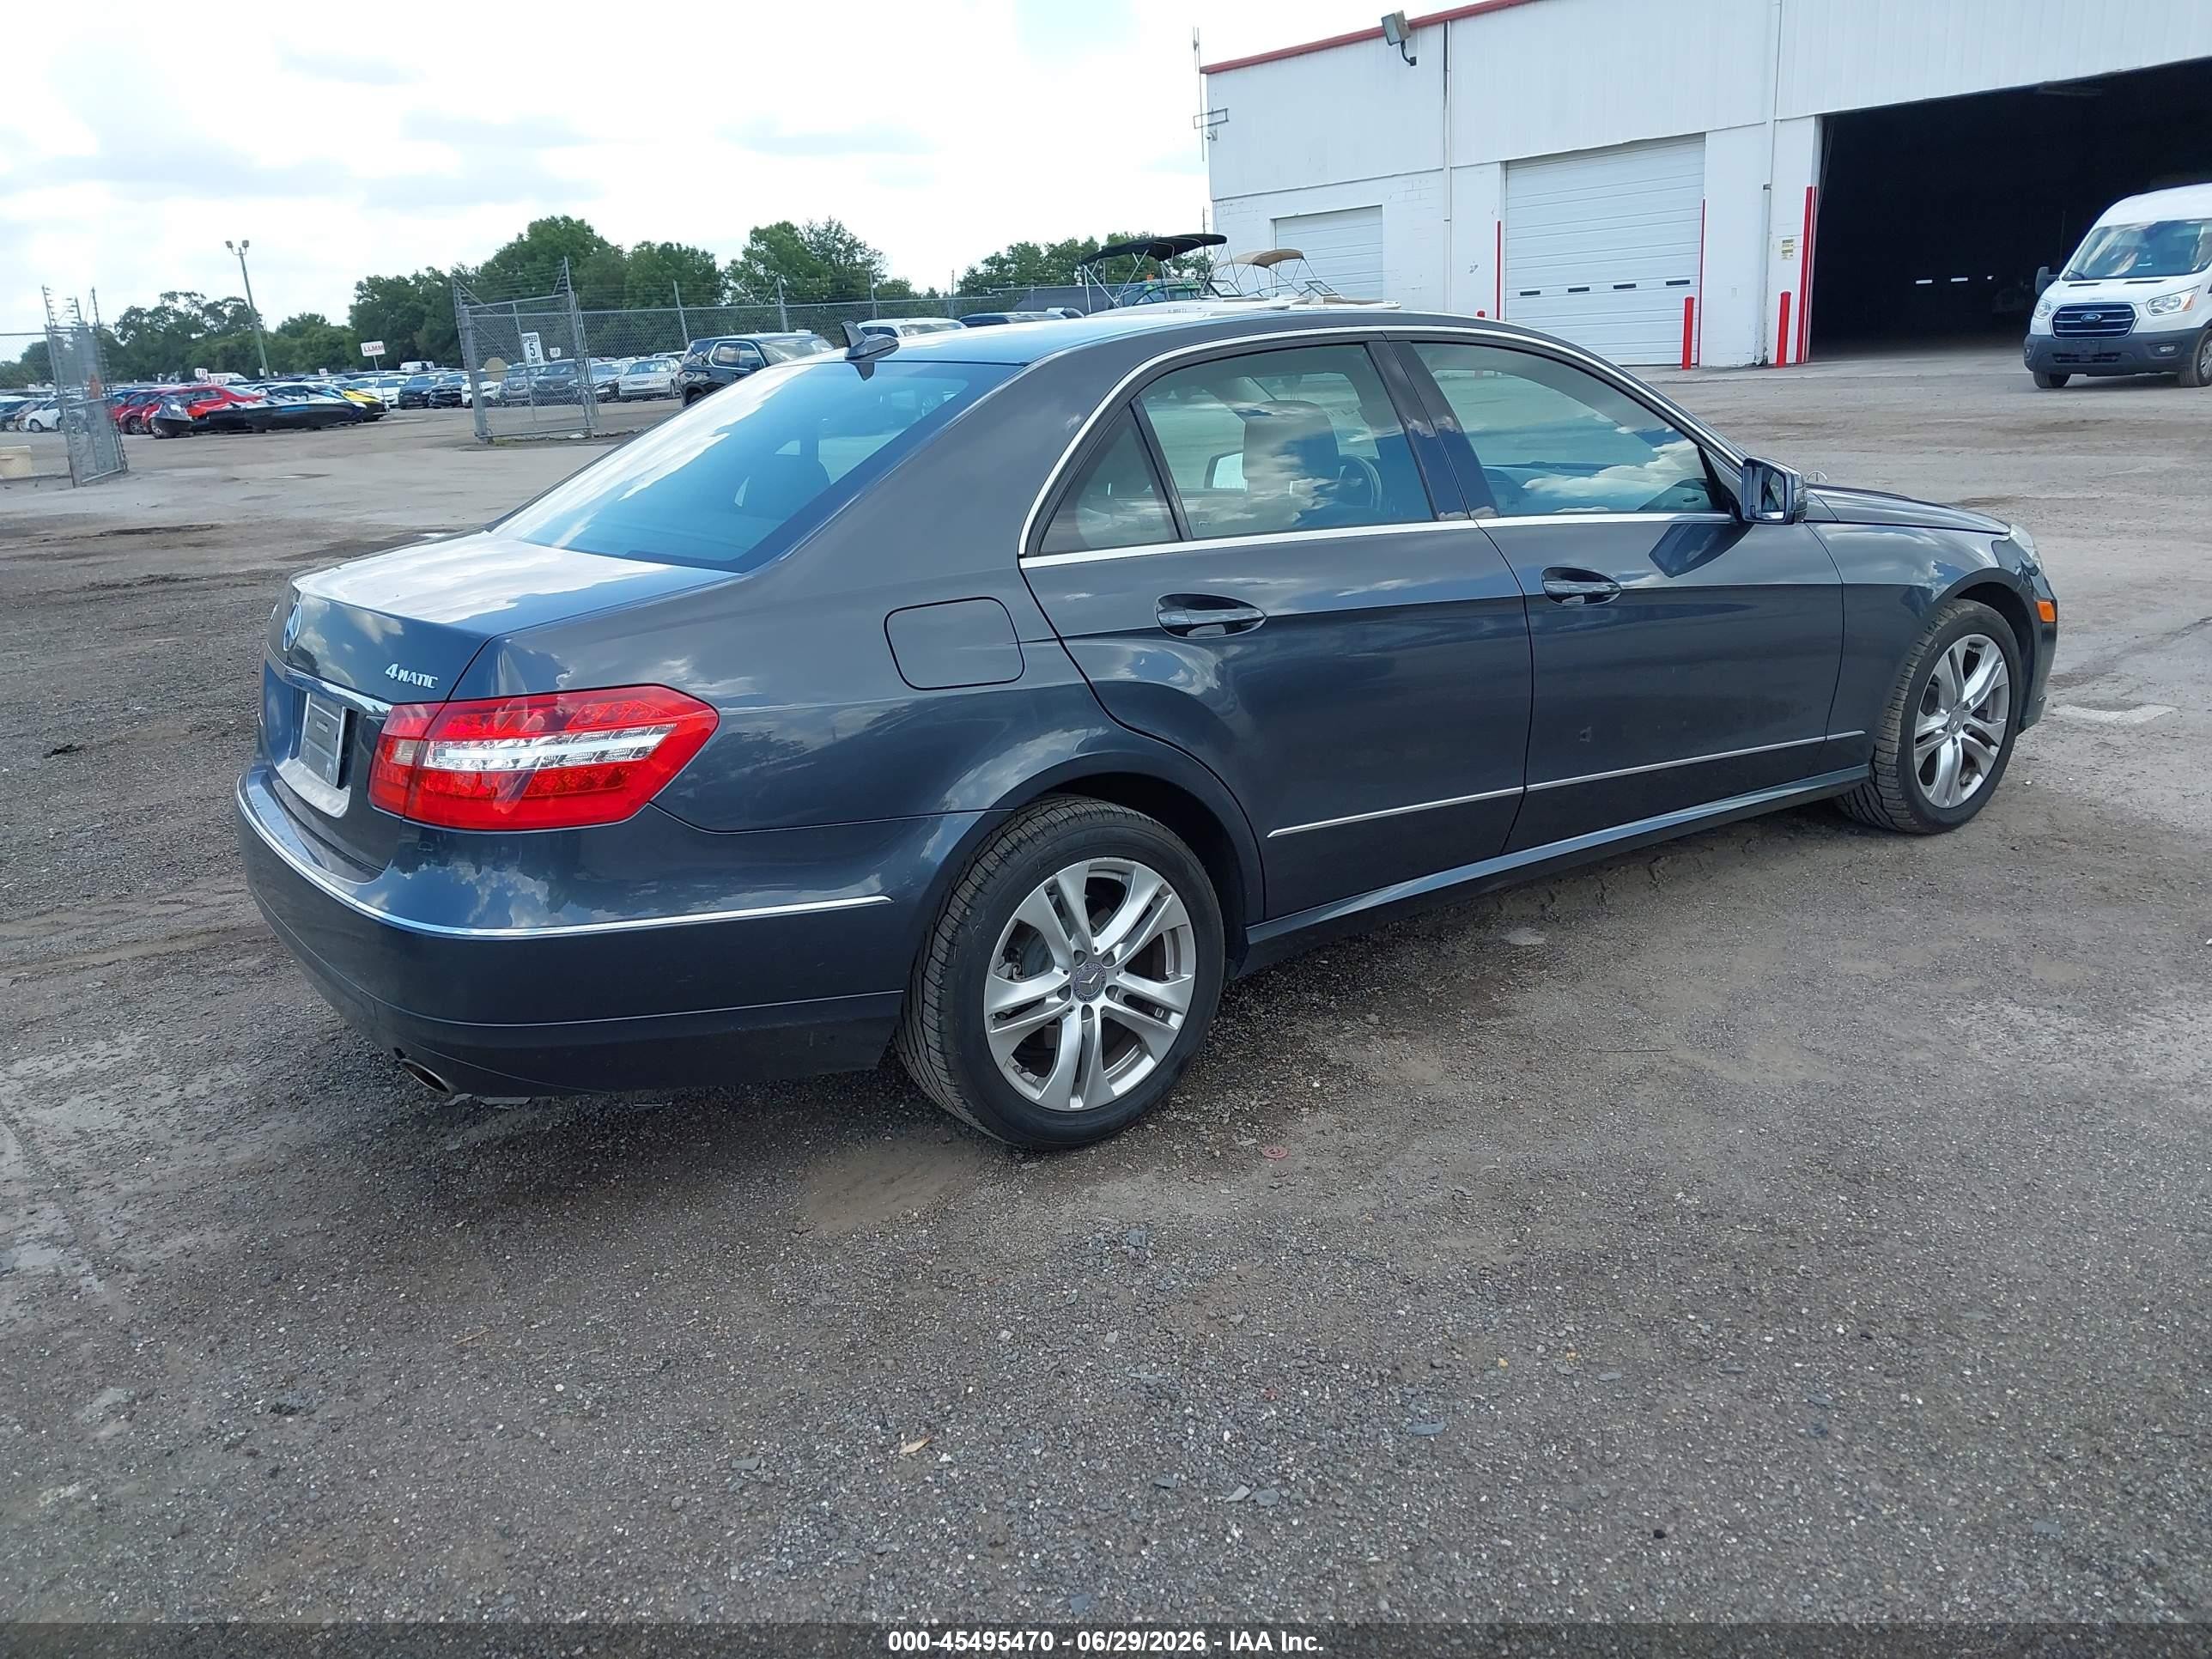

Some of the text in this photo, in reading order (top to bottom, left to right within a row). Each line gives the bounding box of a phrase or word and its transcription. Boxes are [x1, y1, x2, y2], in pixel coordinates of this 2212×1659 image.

[528, 343, 536, 357] 5
[527, 357, 541, 366] LIMIT
[385, 663, 439, 689] 4MATIC
